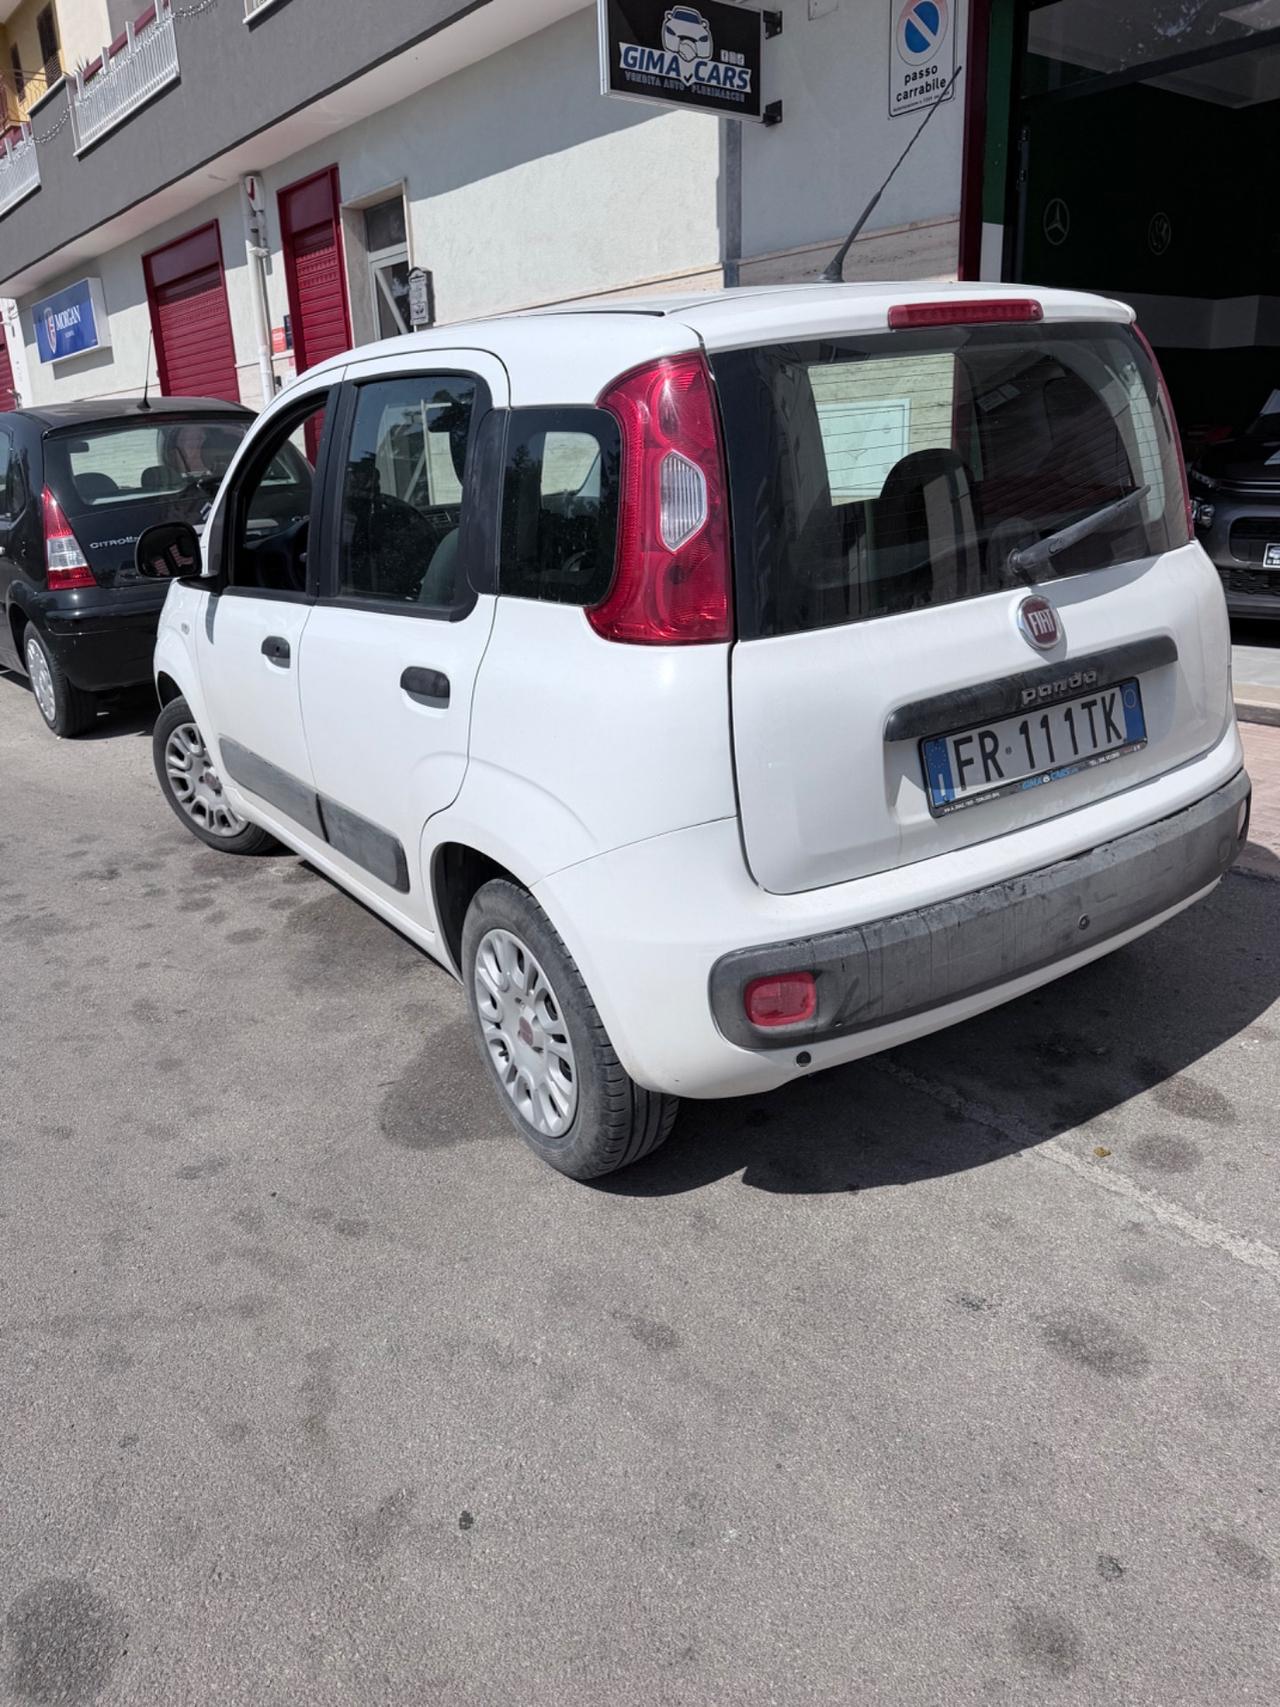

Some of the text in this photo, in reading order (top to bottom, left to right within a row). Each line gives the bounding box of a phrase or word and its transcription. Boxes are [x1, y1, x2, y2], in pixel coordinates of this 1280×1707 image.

[623, 46, 749, 91] GIMA CARS
[625, 70, 663, 87] VENDITA
[664, 77, 685, 91] AUTO
[904, 65, 938, 86] passo
[896, 78, 946, 102] carrabile
[54, 305, 81, 331] MORGAN
[1028, 608, 1056, 636] FIAT
[1021, 669, 1097, 705] panda
[953, 730, 1005, 791] FR
